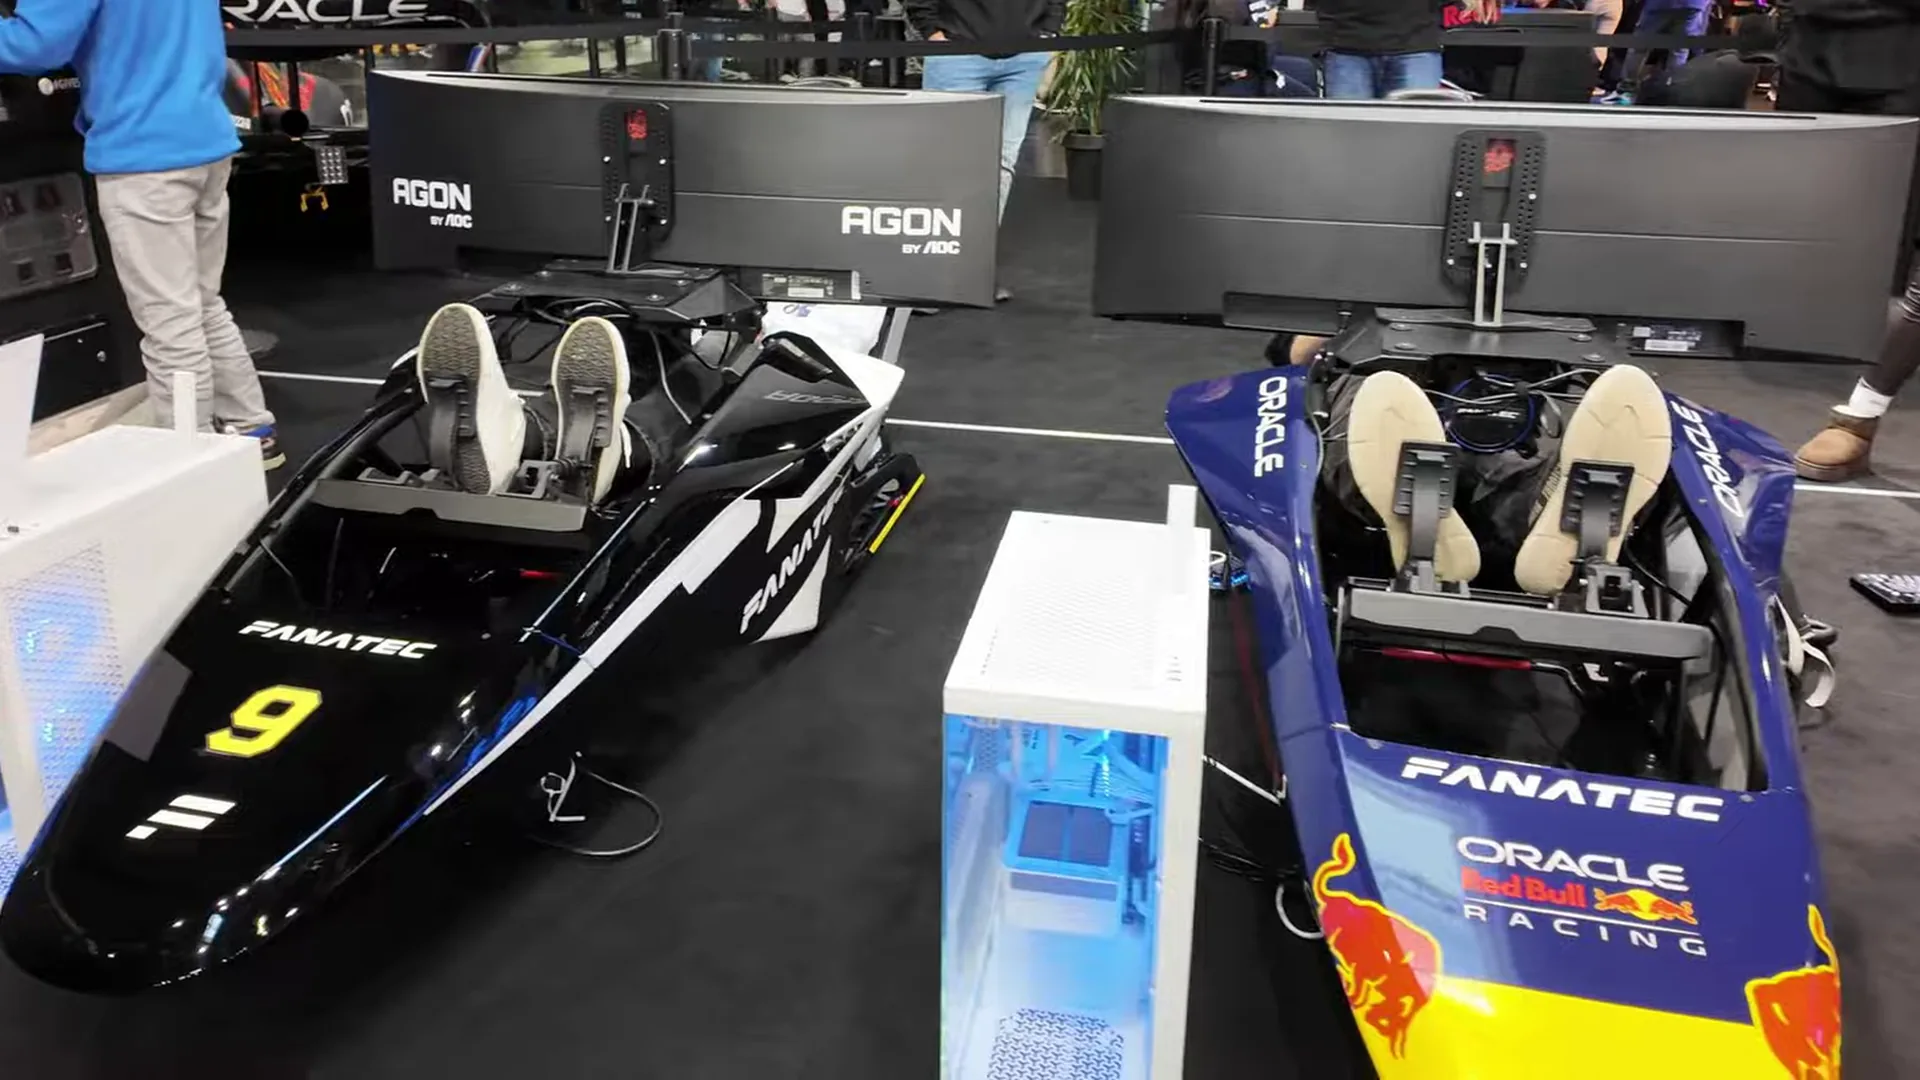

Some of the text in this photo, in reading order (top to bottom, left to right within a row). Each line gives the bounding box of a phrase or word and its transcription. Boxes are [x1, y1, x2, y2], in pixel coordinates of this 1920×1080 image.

[221, 0, 433, 23] RACLE
[393, 178, 472, 211] AGON
[430, 214, 473, 229] BY AOC
[842, 205, 962, 237] AGON
[902, 240, 961, 254] BY AOC
[1254, 376, 1288, 478] ORACLE
[1669, 400, 1745, 518] ORACLE
[238, 620, 438, 659] FANATEC
[204, 683, 324, 758] 9
[1401, 756, 1724, 822] FANATEC
[1457, 836, 1690, 892] ORACLE
[1461, 866, 1587, 909] Red Bull
[1463, 904, 1708, 957] RACING
